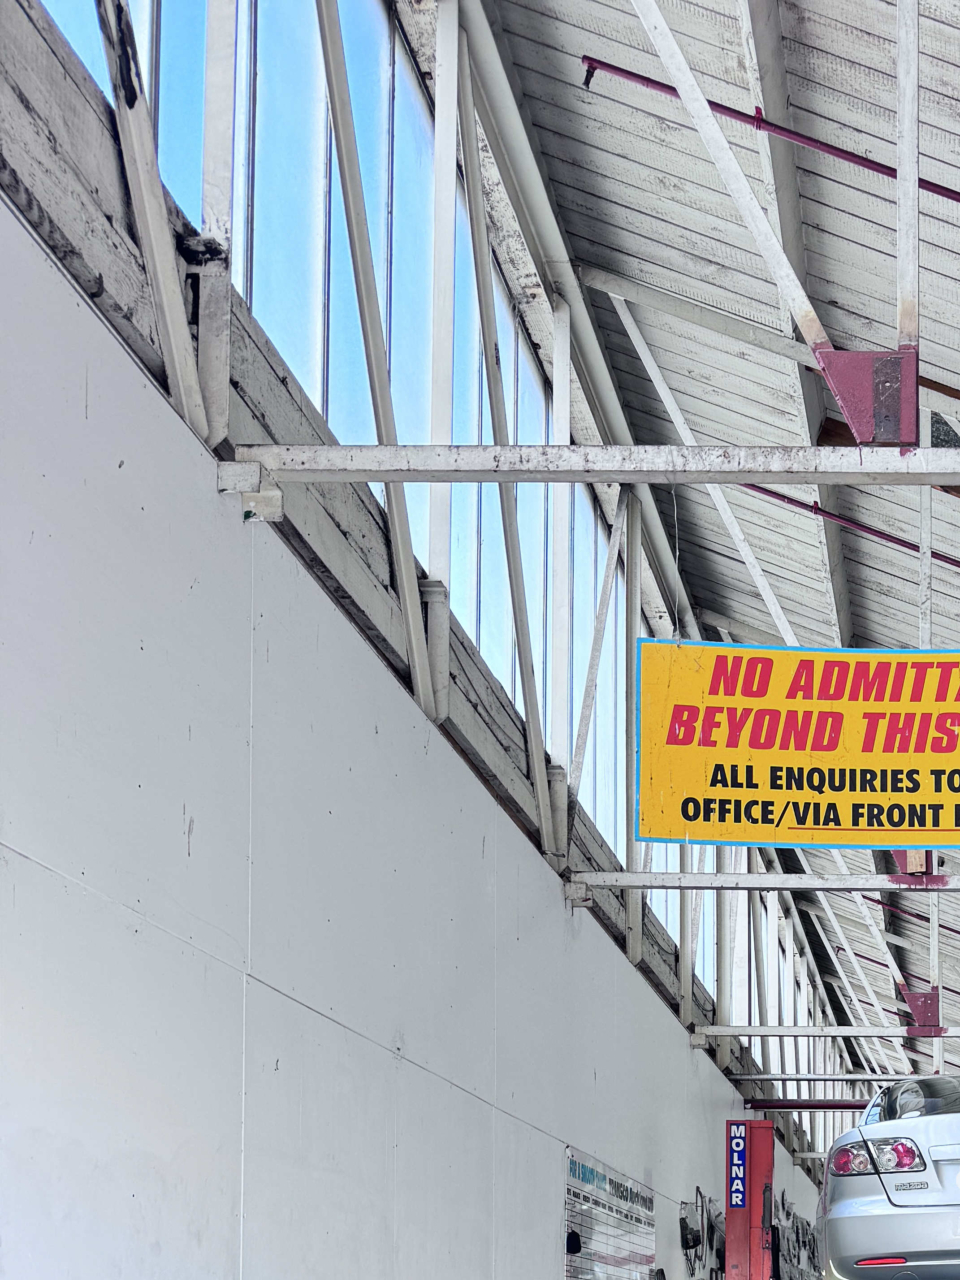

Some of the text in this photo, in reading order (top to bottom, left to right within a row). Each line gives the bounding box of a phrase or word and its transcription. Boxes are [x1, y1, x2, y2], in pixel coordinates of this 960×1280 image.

[708, 654, 774, 699] NO
[666, 704, 845, 752] BEYOND
[709, 763, 759, 790] ALL
[769, 765, 921, 795] ENQUIRIES
[680, 797, 842, 828] OFFICE/VIA
[851, 802, 944, 828] FRONT
[730, 1125, 746, 1205] MOLNAR
